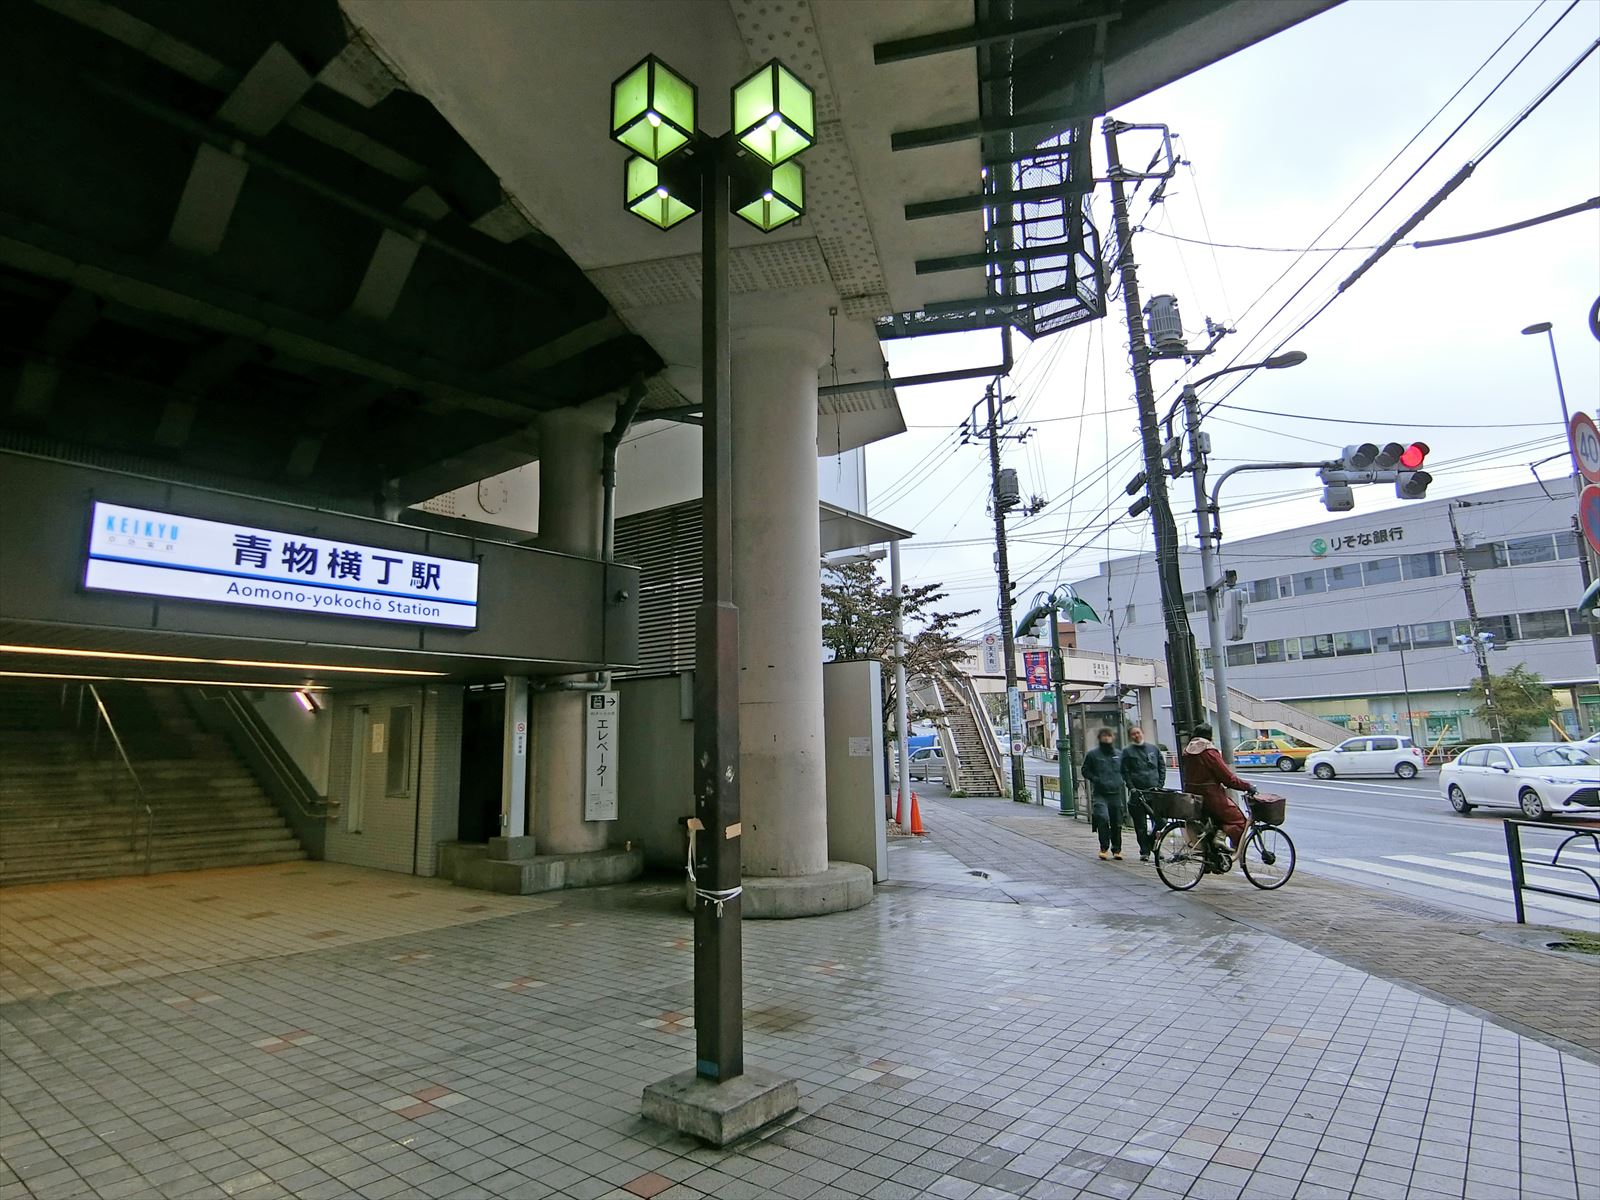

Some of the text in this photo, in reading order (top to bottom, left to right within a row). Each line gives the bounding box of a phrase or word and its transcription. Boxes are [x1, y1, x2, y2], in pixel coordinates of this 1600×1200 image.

[1580, 431, 1599, 464] 40
[106, 515, 180, 541] KEIKYU
[1330, 526, 1403, 551] りそな銀行
[232, 533, 442, 592] 青物横丁駅
[226, 581, 440, 617] Aomono-yokochō Station
[596, 719, 609, 787] エレベーター
